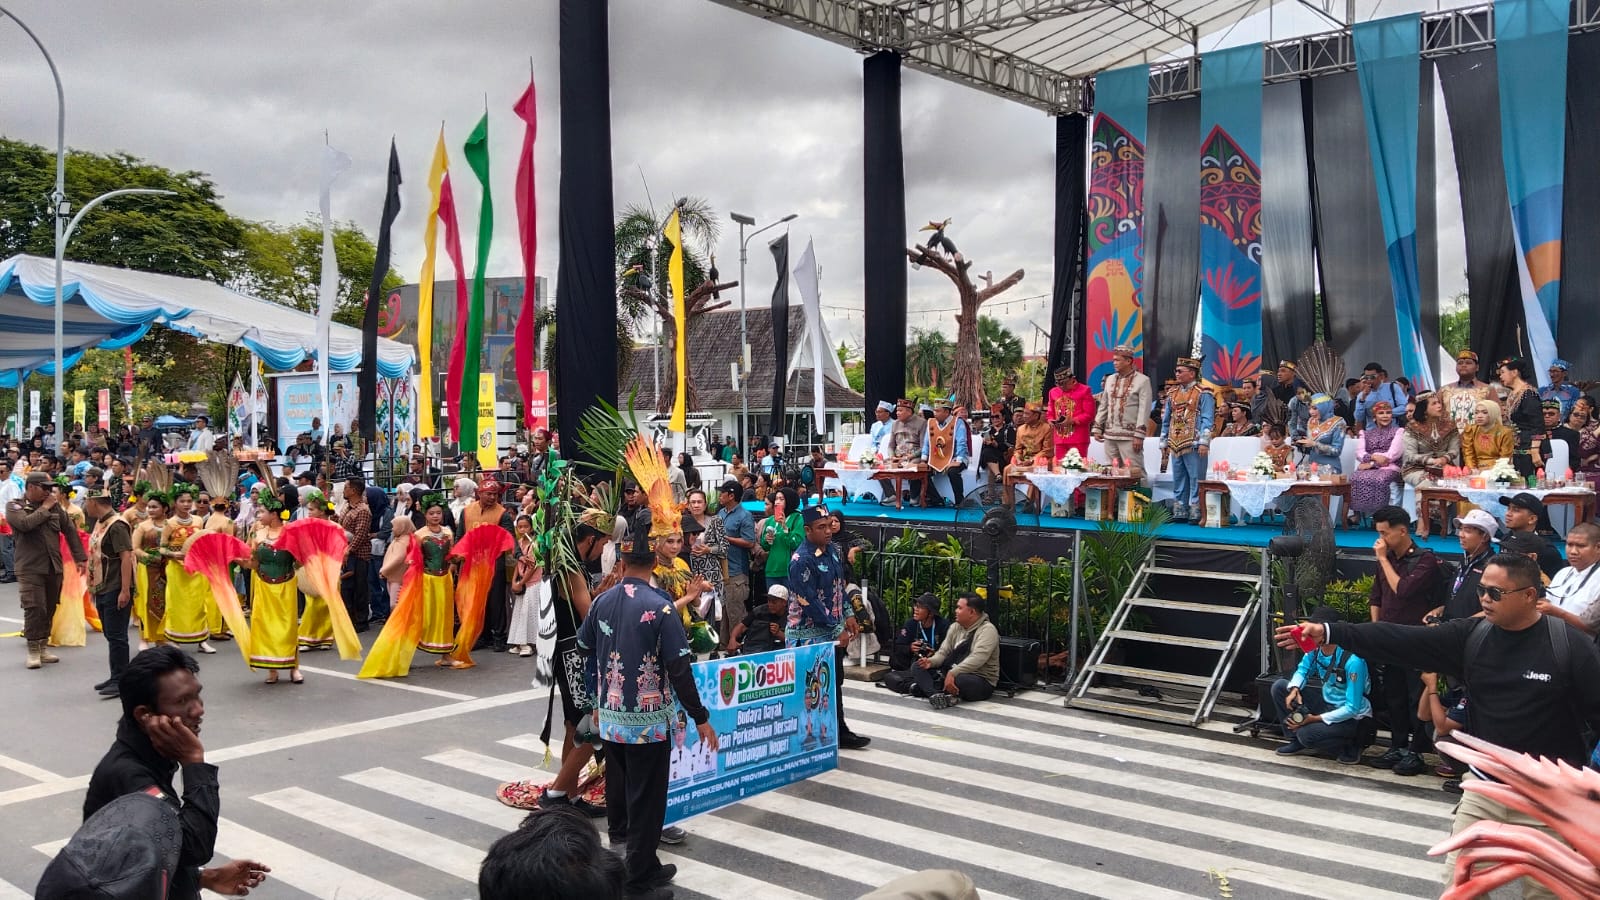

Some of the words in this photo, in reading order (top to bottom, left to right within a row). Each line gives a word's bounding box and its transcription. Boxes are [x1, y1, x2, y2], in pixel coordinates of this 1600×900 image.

[1526, 670, 1552, 682] Jeep
[736, 708, 762, 726] Budaya
[763, 701, 783, 720] Dayak
[718, 734, 732, 750] dan
[732, 724, 773, 746] Perkebunan
[774, 716, 798, 736] Bersatu
[726, 743, 768, 768] Membangun
[768, 736, 790, 756] Negeri
[667, 792, 691, 807] DINAS
[692, 778, 740, 800] PERKEBUNAN
[740, 768, 770, 784] PROVINSI
[770, 757, 810, 775] KALIMANTAN
[811, 750, 834, 763] TENGAH
